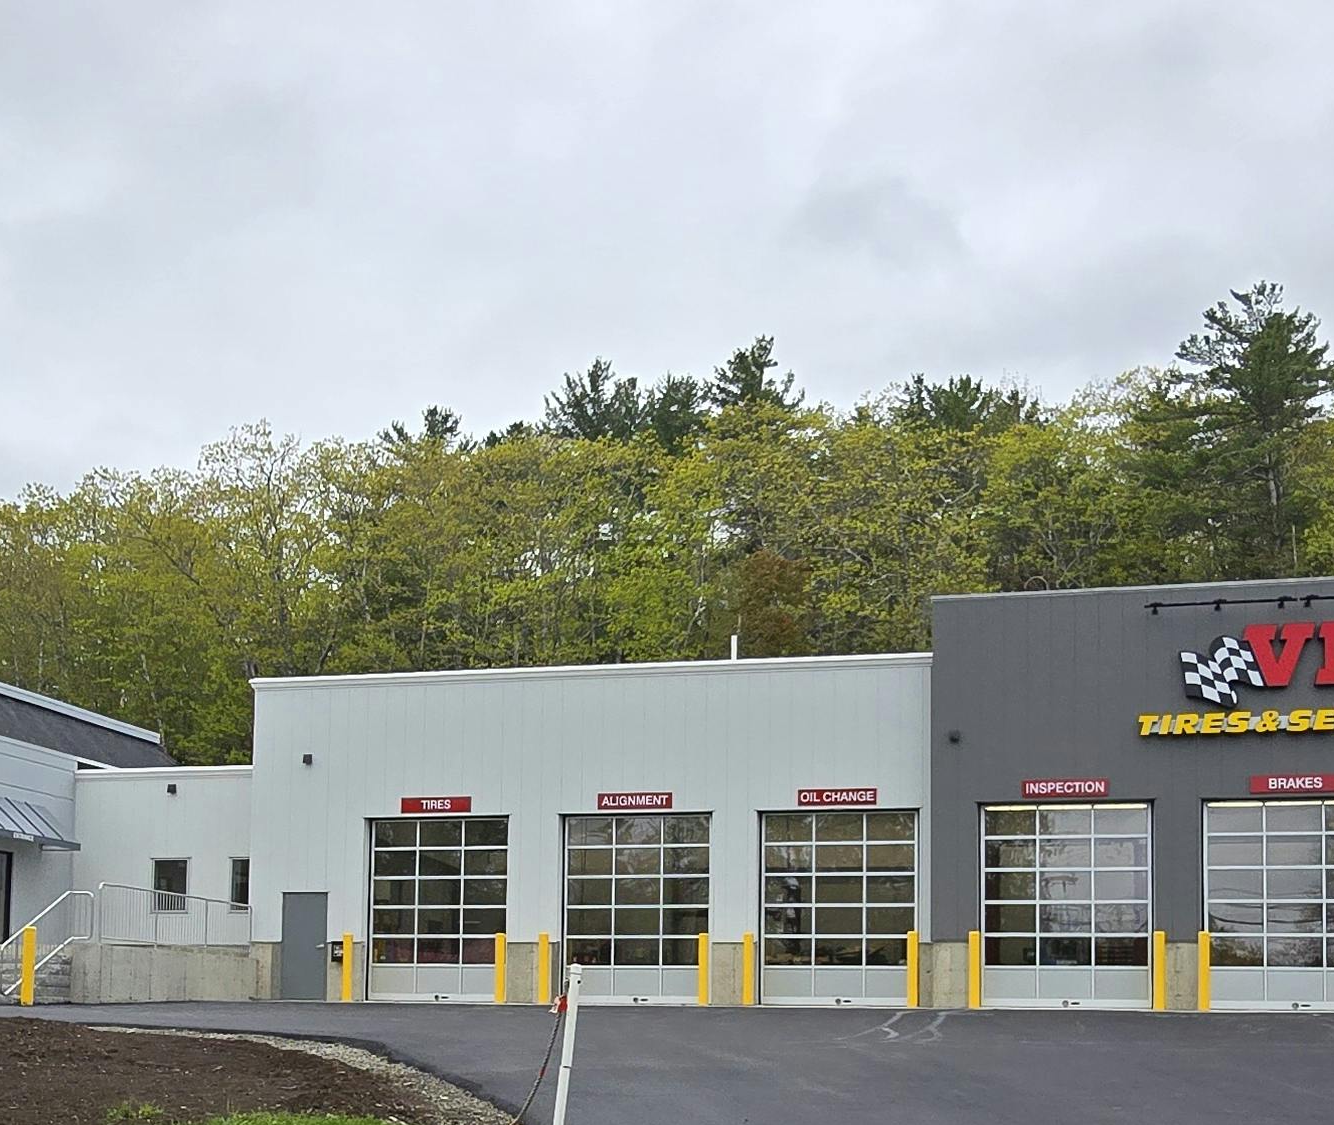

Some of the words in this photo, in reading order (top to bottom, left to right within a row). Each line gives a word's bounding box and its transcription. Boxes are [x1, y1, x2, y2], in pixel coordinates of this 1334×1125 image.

[1024, 781, 1106, 795] INSPECTION
[1267, 776, 1323, 790] BRAKES
[601, 794, 669, 807] ALIGNMENT
[799, 791, 821, 803] OIL
[822, 790, 875, 803] CHANGE
[420, 799, 452, 811] TIRES
